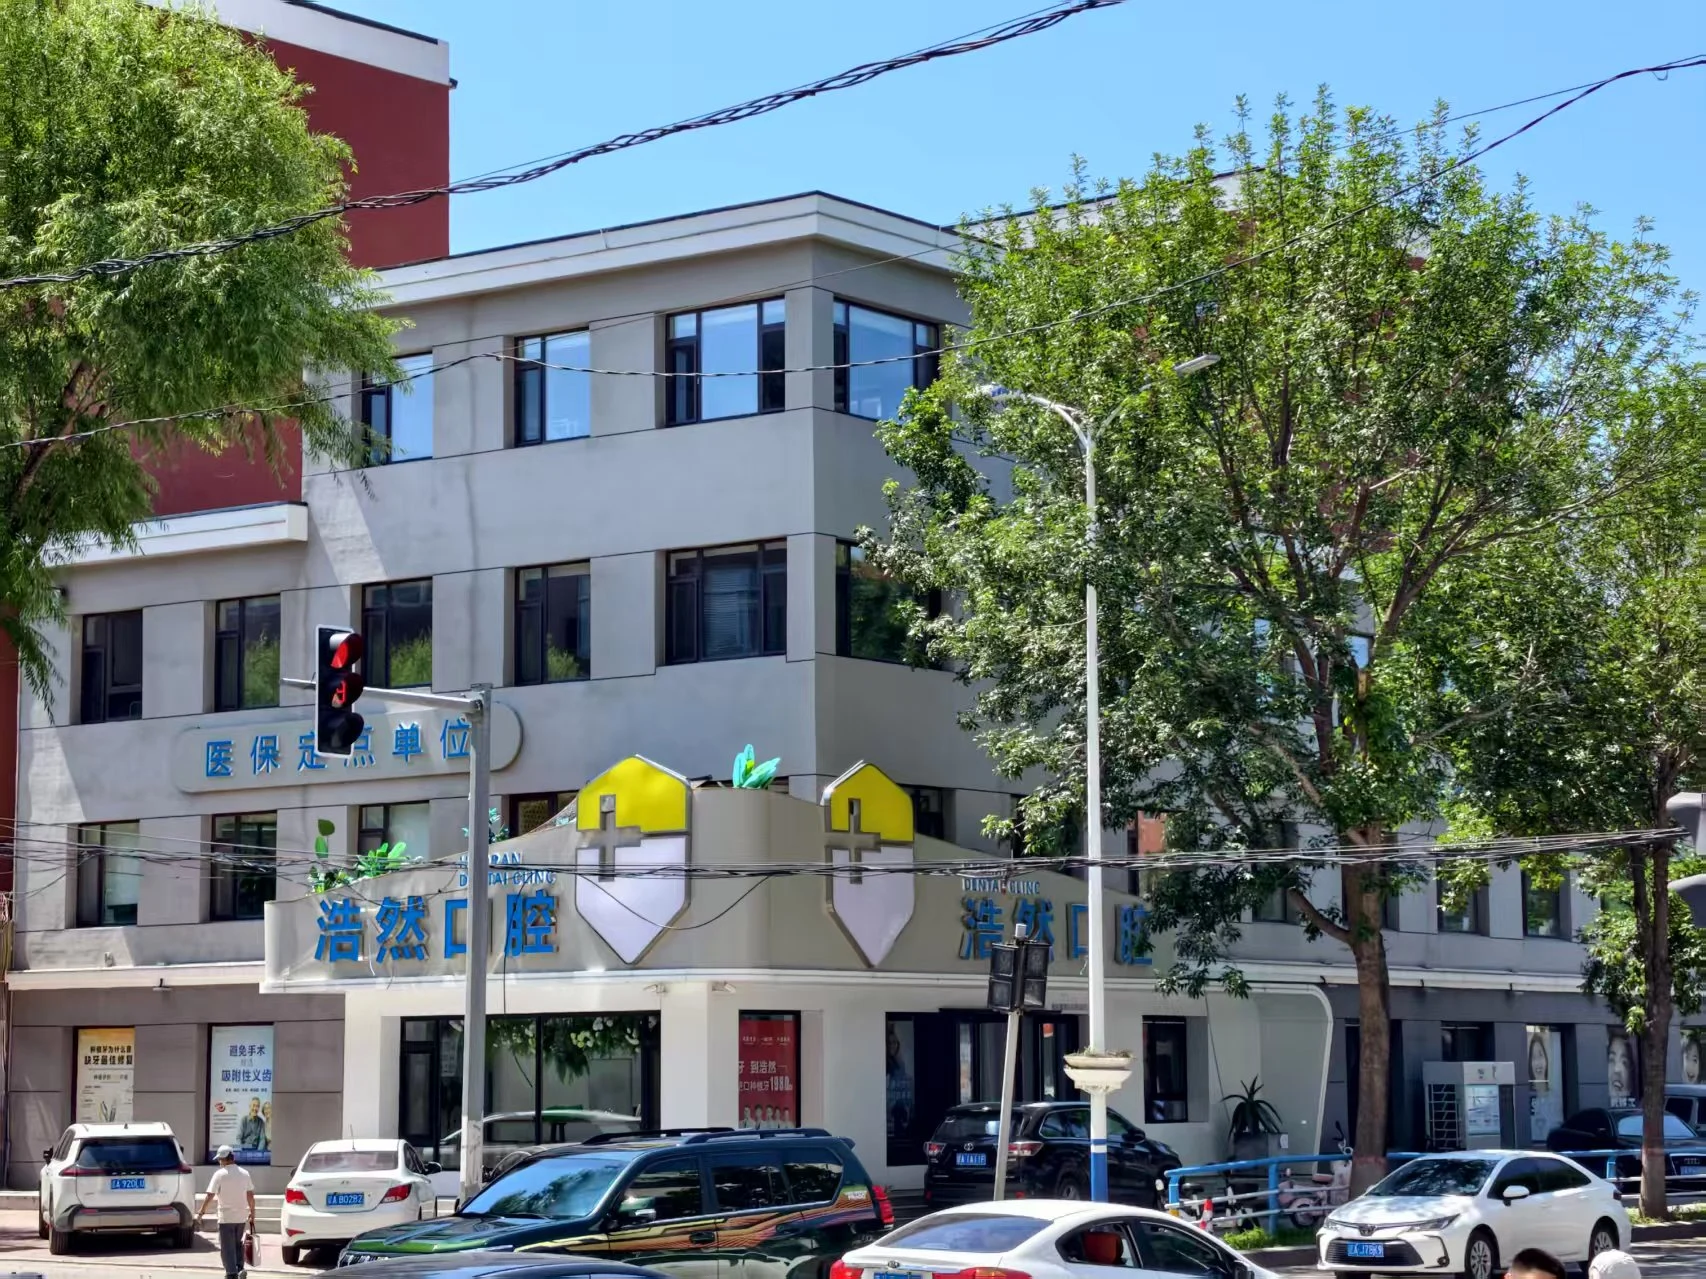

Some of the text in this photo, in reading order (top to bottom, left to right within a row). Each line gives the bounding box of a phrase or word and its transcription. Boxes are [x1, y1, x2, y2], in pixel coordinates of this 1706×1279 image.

[460, 853, 521, 867] HRAN
[962, 878, 1006, 893] DENTA
[314, 888, 557, 964] 浩然口腔
[229, 1044, 266, 1057] 避免手术
